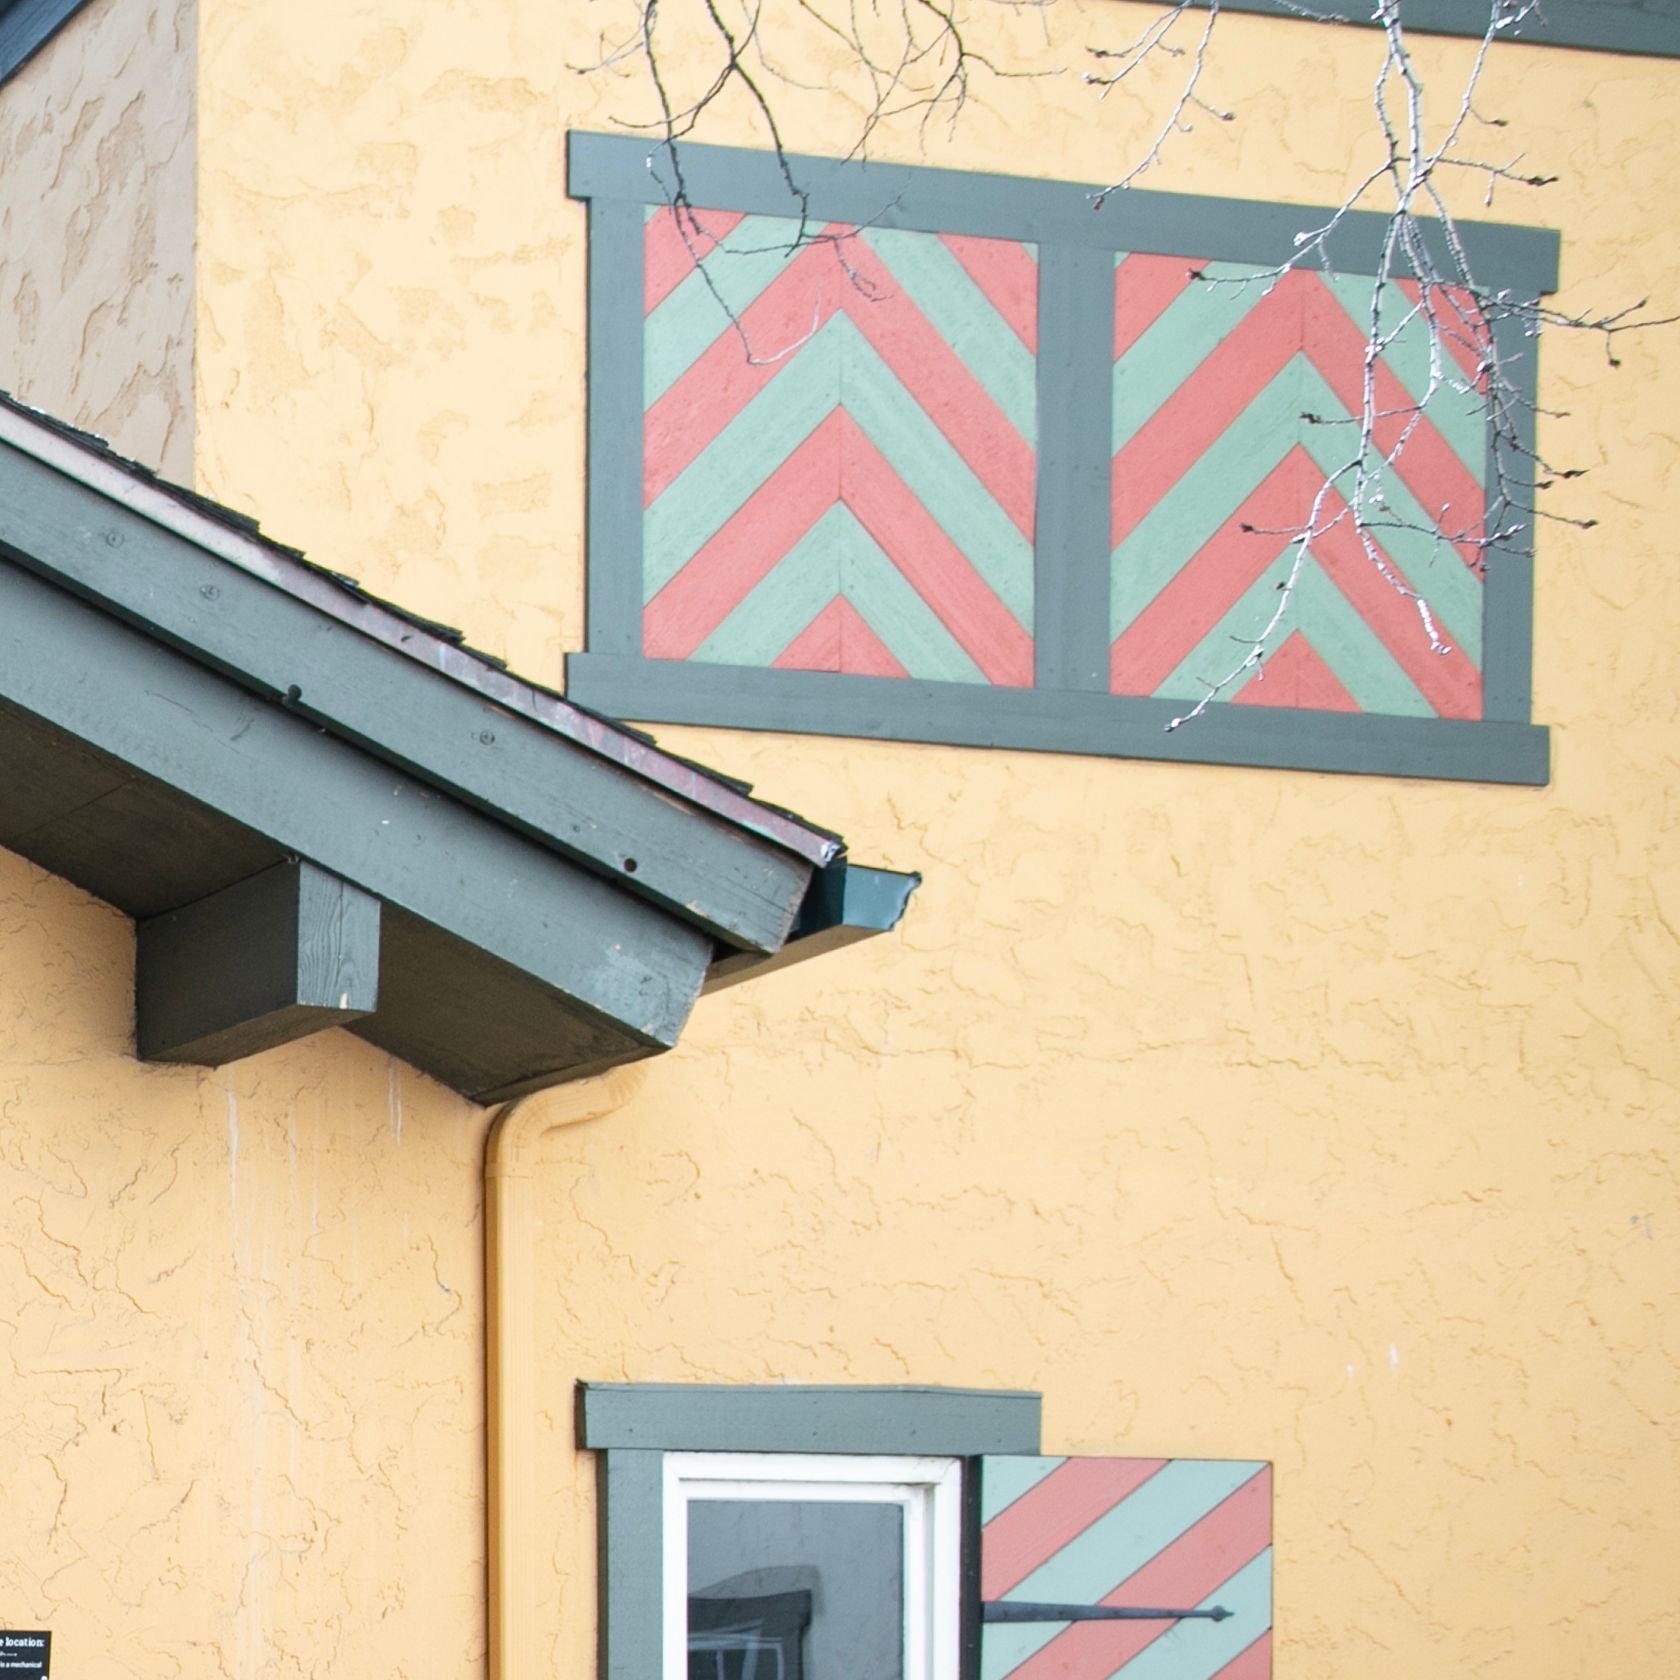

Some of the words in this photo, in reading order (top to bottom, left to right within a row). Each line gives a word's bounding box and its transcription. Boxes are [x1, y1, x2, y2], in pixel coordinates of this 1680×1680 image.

[5, 1636, 45, 1648] location:
[0, 1660, 5, 1668] is
[10, 1660, 42, 1668] mechanical
